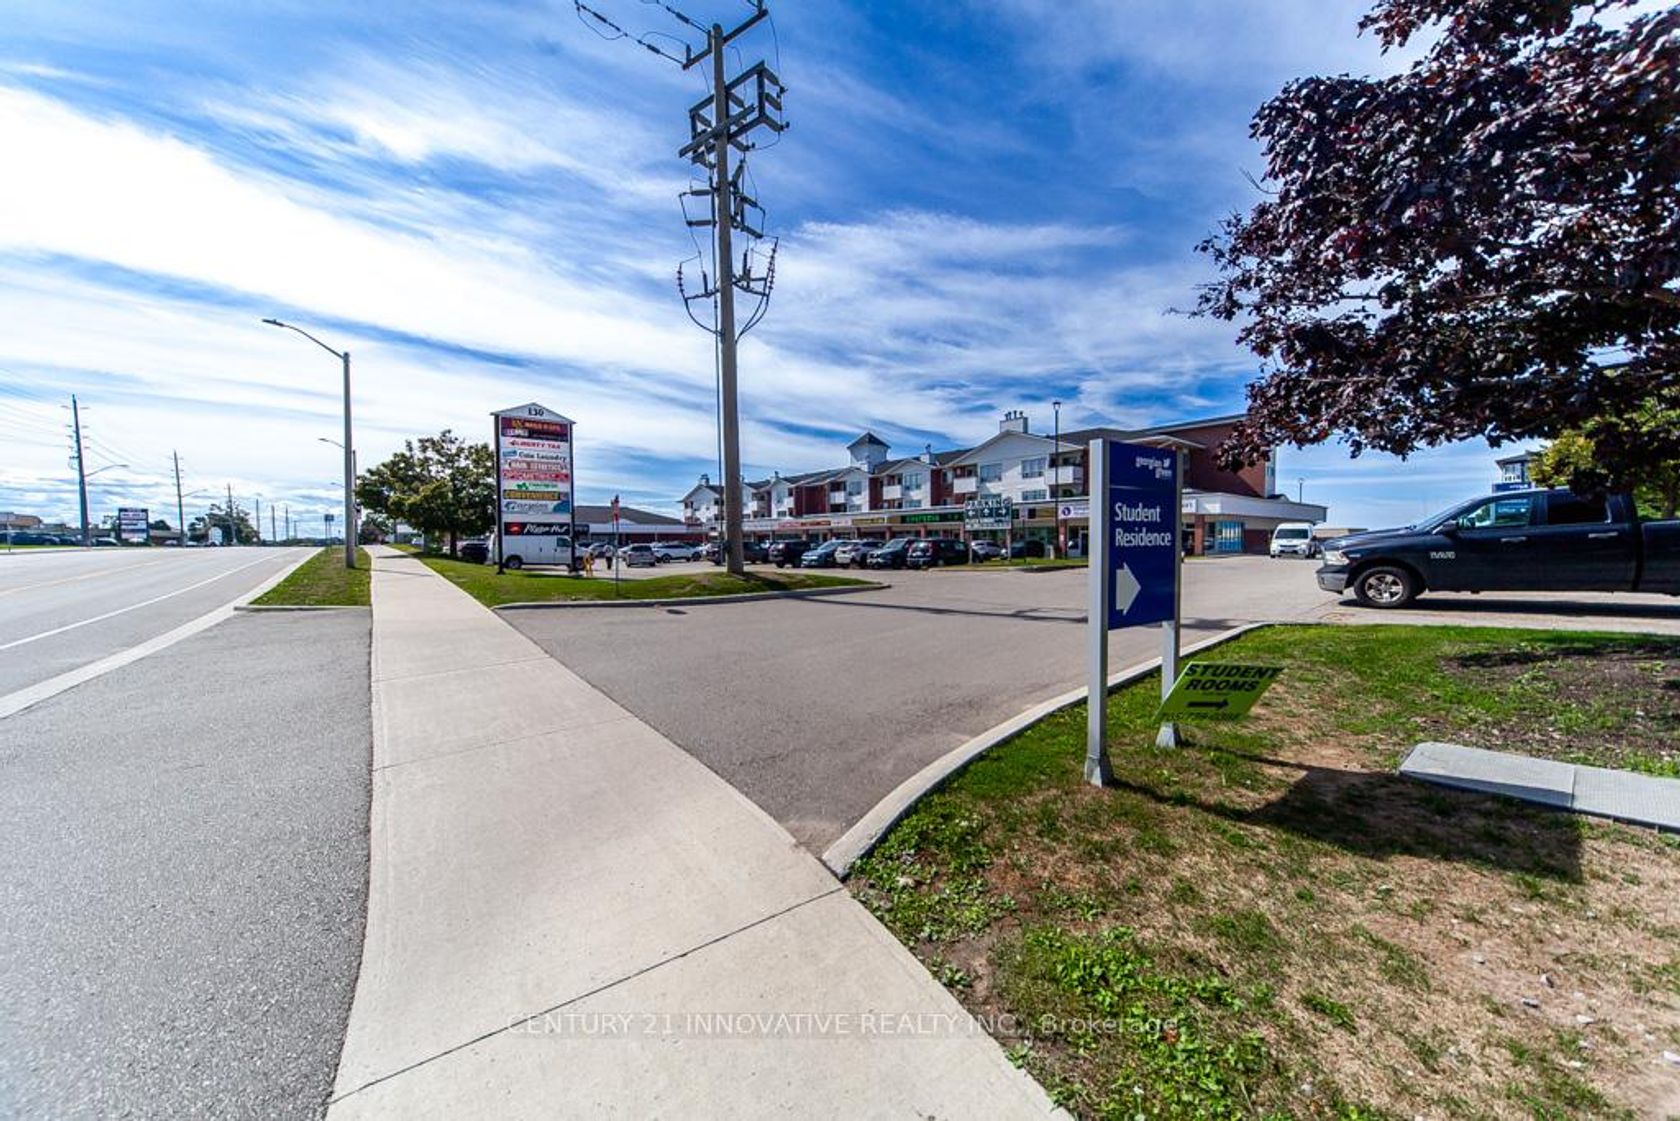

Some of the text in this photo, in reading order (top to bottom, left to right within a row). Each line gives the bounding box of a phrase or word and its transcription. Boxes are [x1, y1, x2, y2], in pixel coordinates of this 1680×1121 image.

[1115, 502, 1160, 522] Student
[1115, 527, 1172, 547] Residence
[1185, 664, 1284, 679] STUDENT
[1185, 679, 1260, 692] ROOMS
